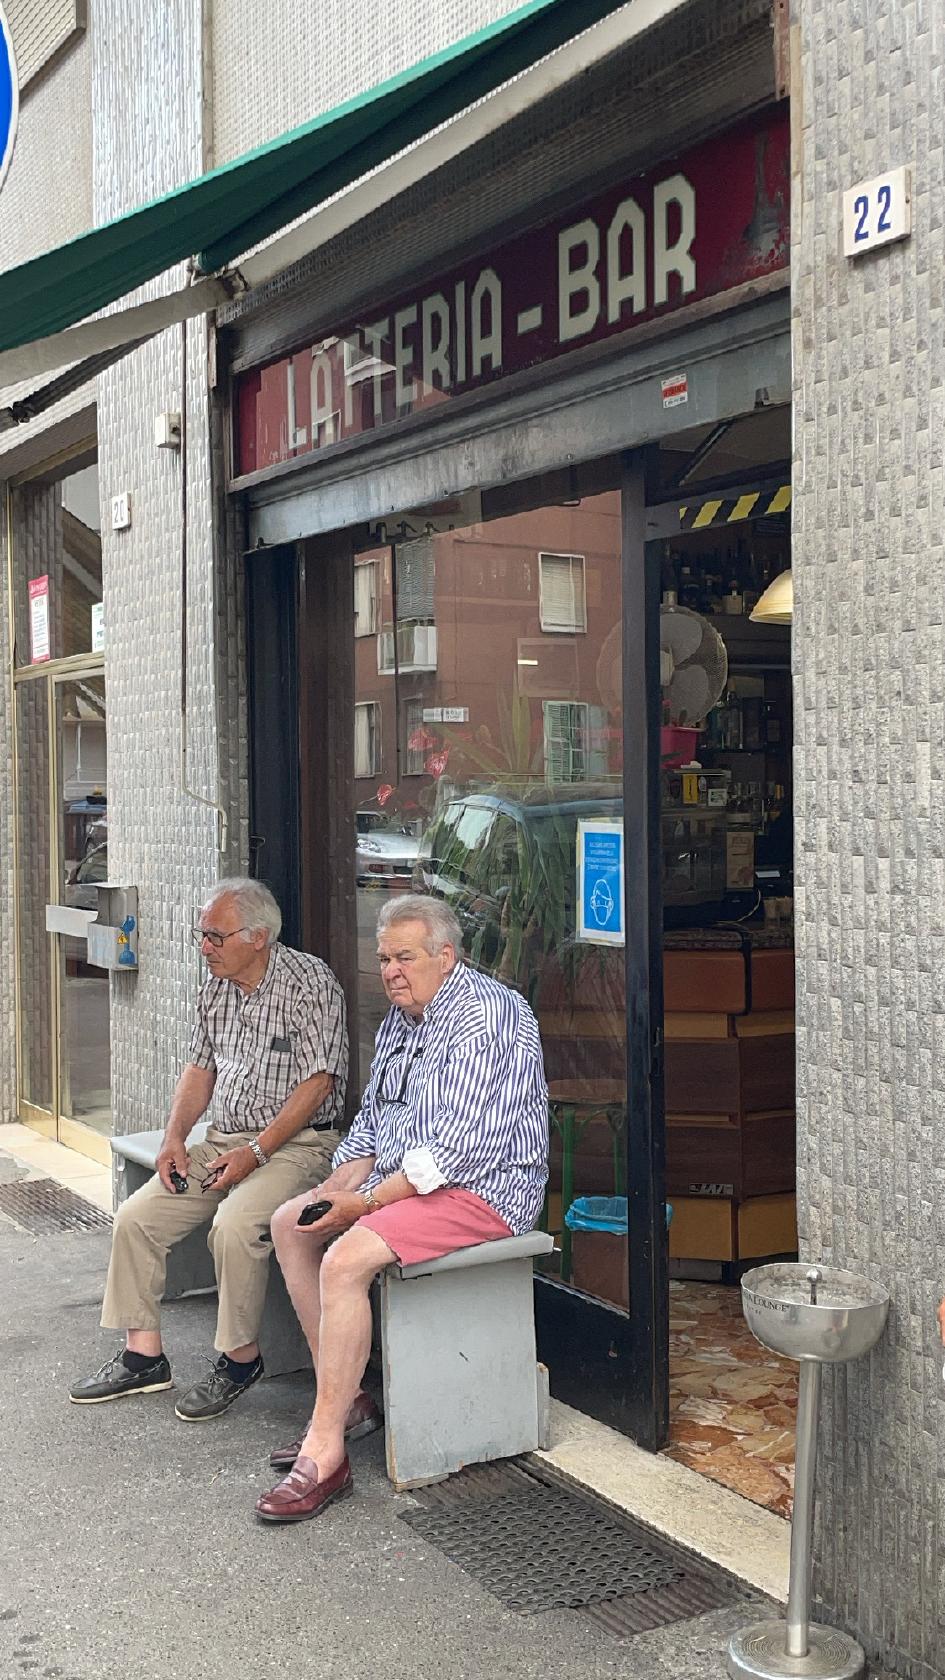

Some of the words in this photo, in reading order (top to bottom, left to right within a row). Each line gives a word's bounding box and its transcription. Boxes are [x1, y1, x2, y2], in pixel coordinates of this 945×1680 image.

[854, 185, 892, 243] 22
[287, 267, 502, 449] LATTERIA
[559, 173, 697, 342] BAR
